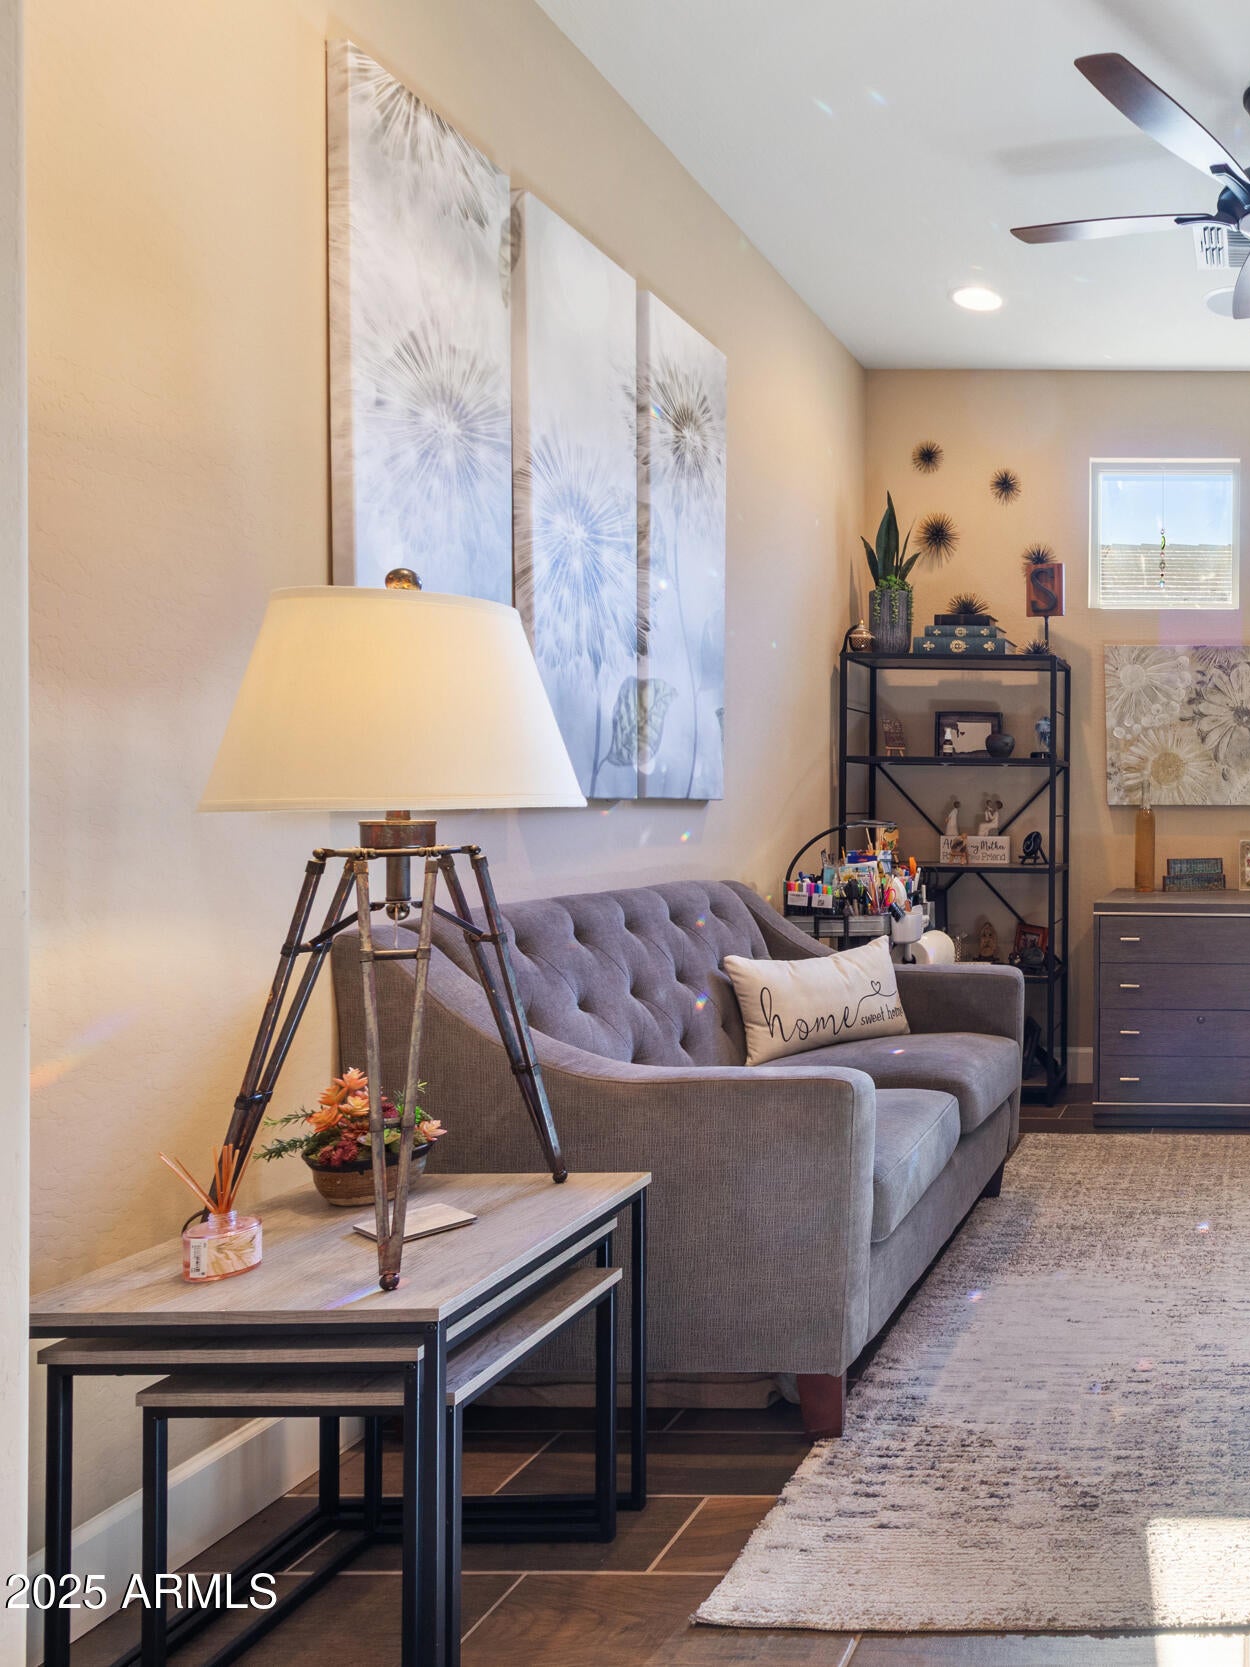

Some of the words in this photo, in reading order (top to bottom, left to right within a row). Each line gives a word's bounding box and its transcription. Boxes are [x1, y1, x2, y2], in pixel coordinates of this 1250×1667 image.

[1030, 567, 1058, 614] S
[980, 840, 1006, 851] Mother
[981, 852, 1006, 861] Friend
[760, 986, 858, 1042] home
[860, 1006, 885, 1026] sweet
